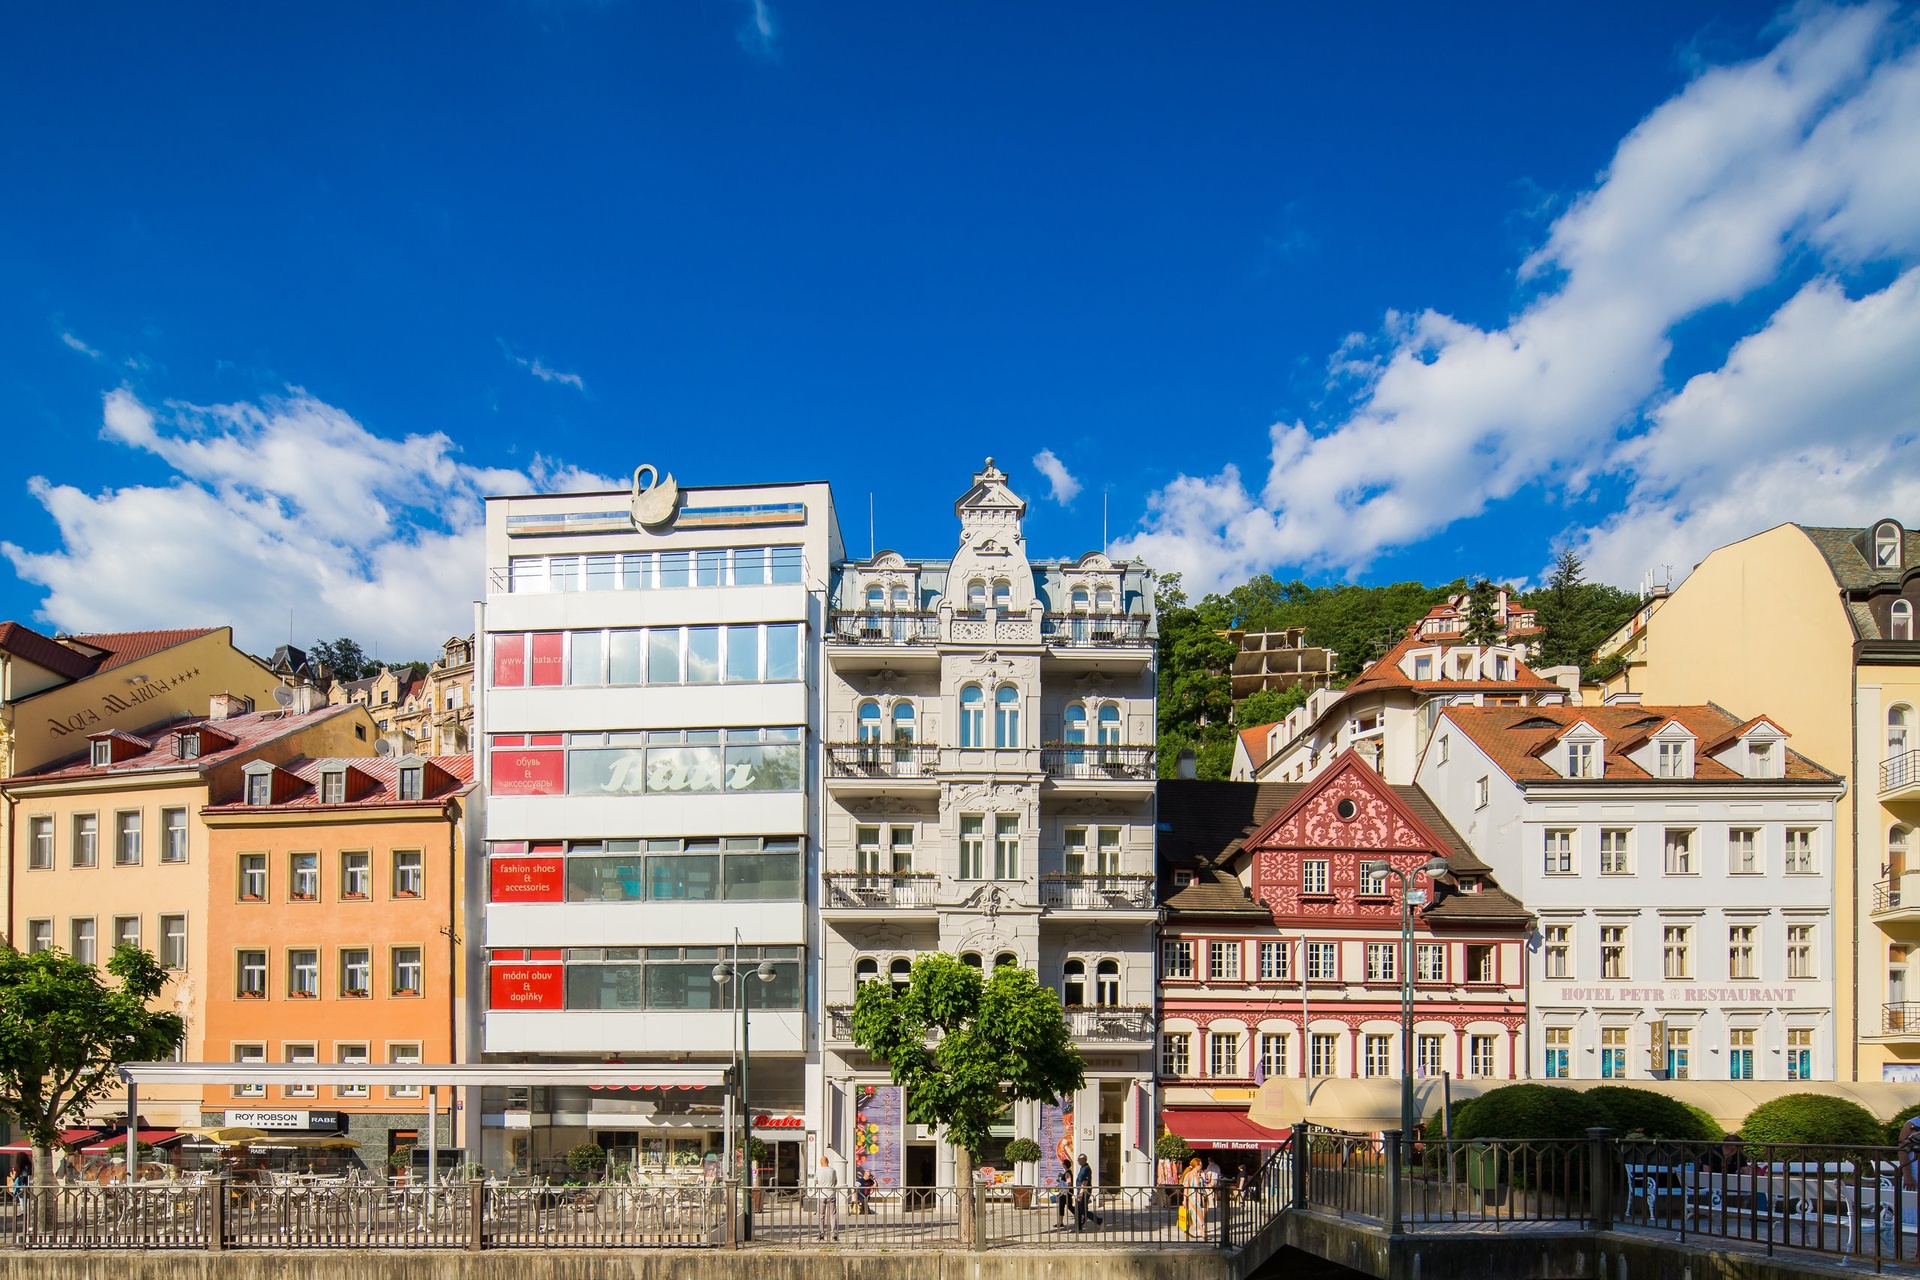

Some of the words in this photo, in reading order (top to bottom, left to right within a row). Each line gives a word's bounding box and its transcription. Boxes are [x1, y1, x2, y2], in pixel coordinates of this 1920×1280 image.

[47, 708, 101, 739] AQUA
[101, 679, 171, 717] MARINA
[516, 757, 541, 768] обувь
[503, 780, 553, 789] аксессуары
[500, 864, 531, 873] fashion
[532, 865, 556, 873] shoes
[505, 883, 550, 892] accessories
[503, 971, 530, 980] módní
[531, 971, 553, 980] obuv
[510, 992, 544, 1003] doplňky
[1561, 988, 1615, 1001] HOTEL
[1619, 988, 1665, 1001] PETR
[1684, 988, 1796, 1002] RESTAURANT
[235, 1113, 254, 1121] ROY
[257, 1113, 297, 1121] ROBSON
[752, 1114, 802, 1128] Bata
[884, 1093, 893, 1174] SUPERMARKET
